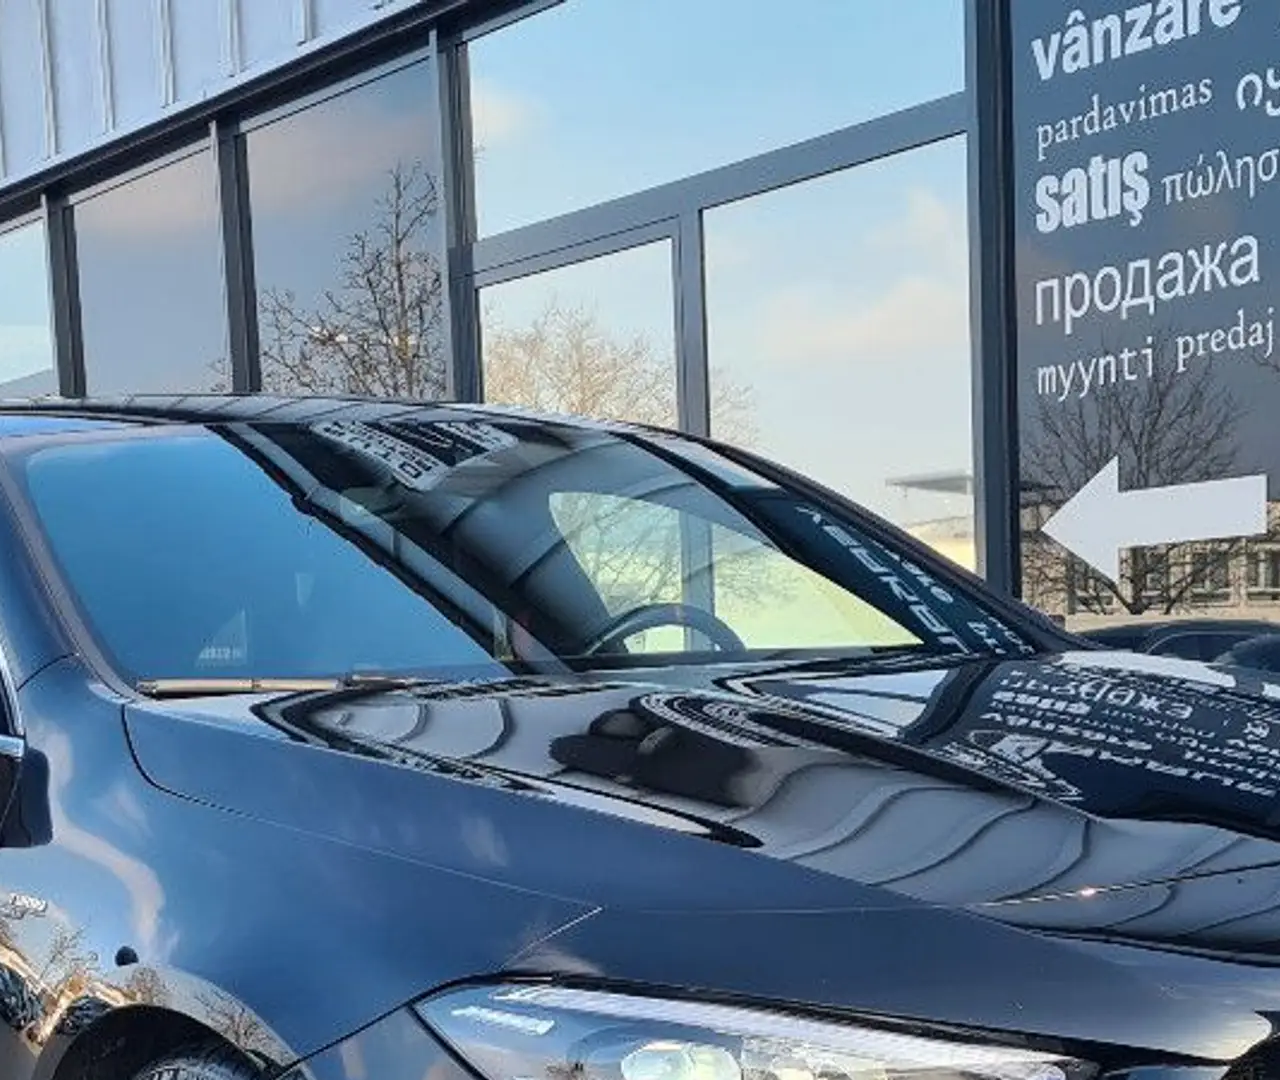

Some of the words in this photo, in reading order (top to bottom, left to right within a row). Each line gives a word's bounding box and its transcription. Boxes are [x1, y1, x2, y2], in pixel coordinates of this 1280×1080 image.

[1037, 79, 1212, 161] pardavimas
[1036, 152, 1149, 233] satış
[1036, 236, 1259, 334] продажа
[1038, 336, 1152, 402] myynti
[1176, 307, 1273, 372] predaj
